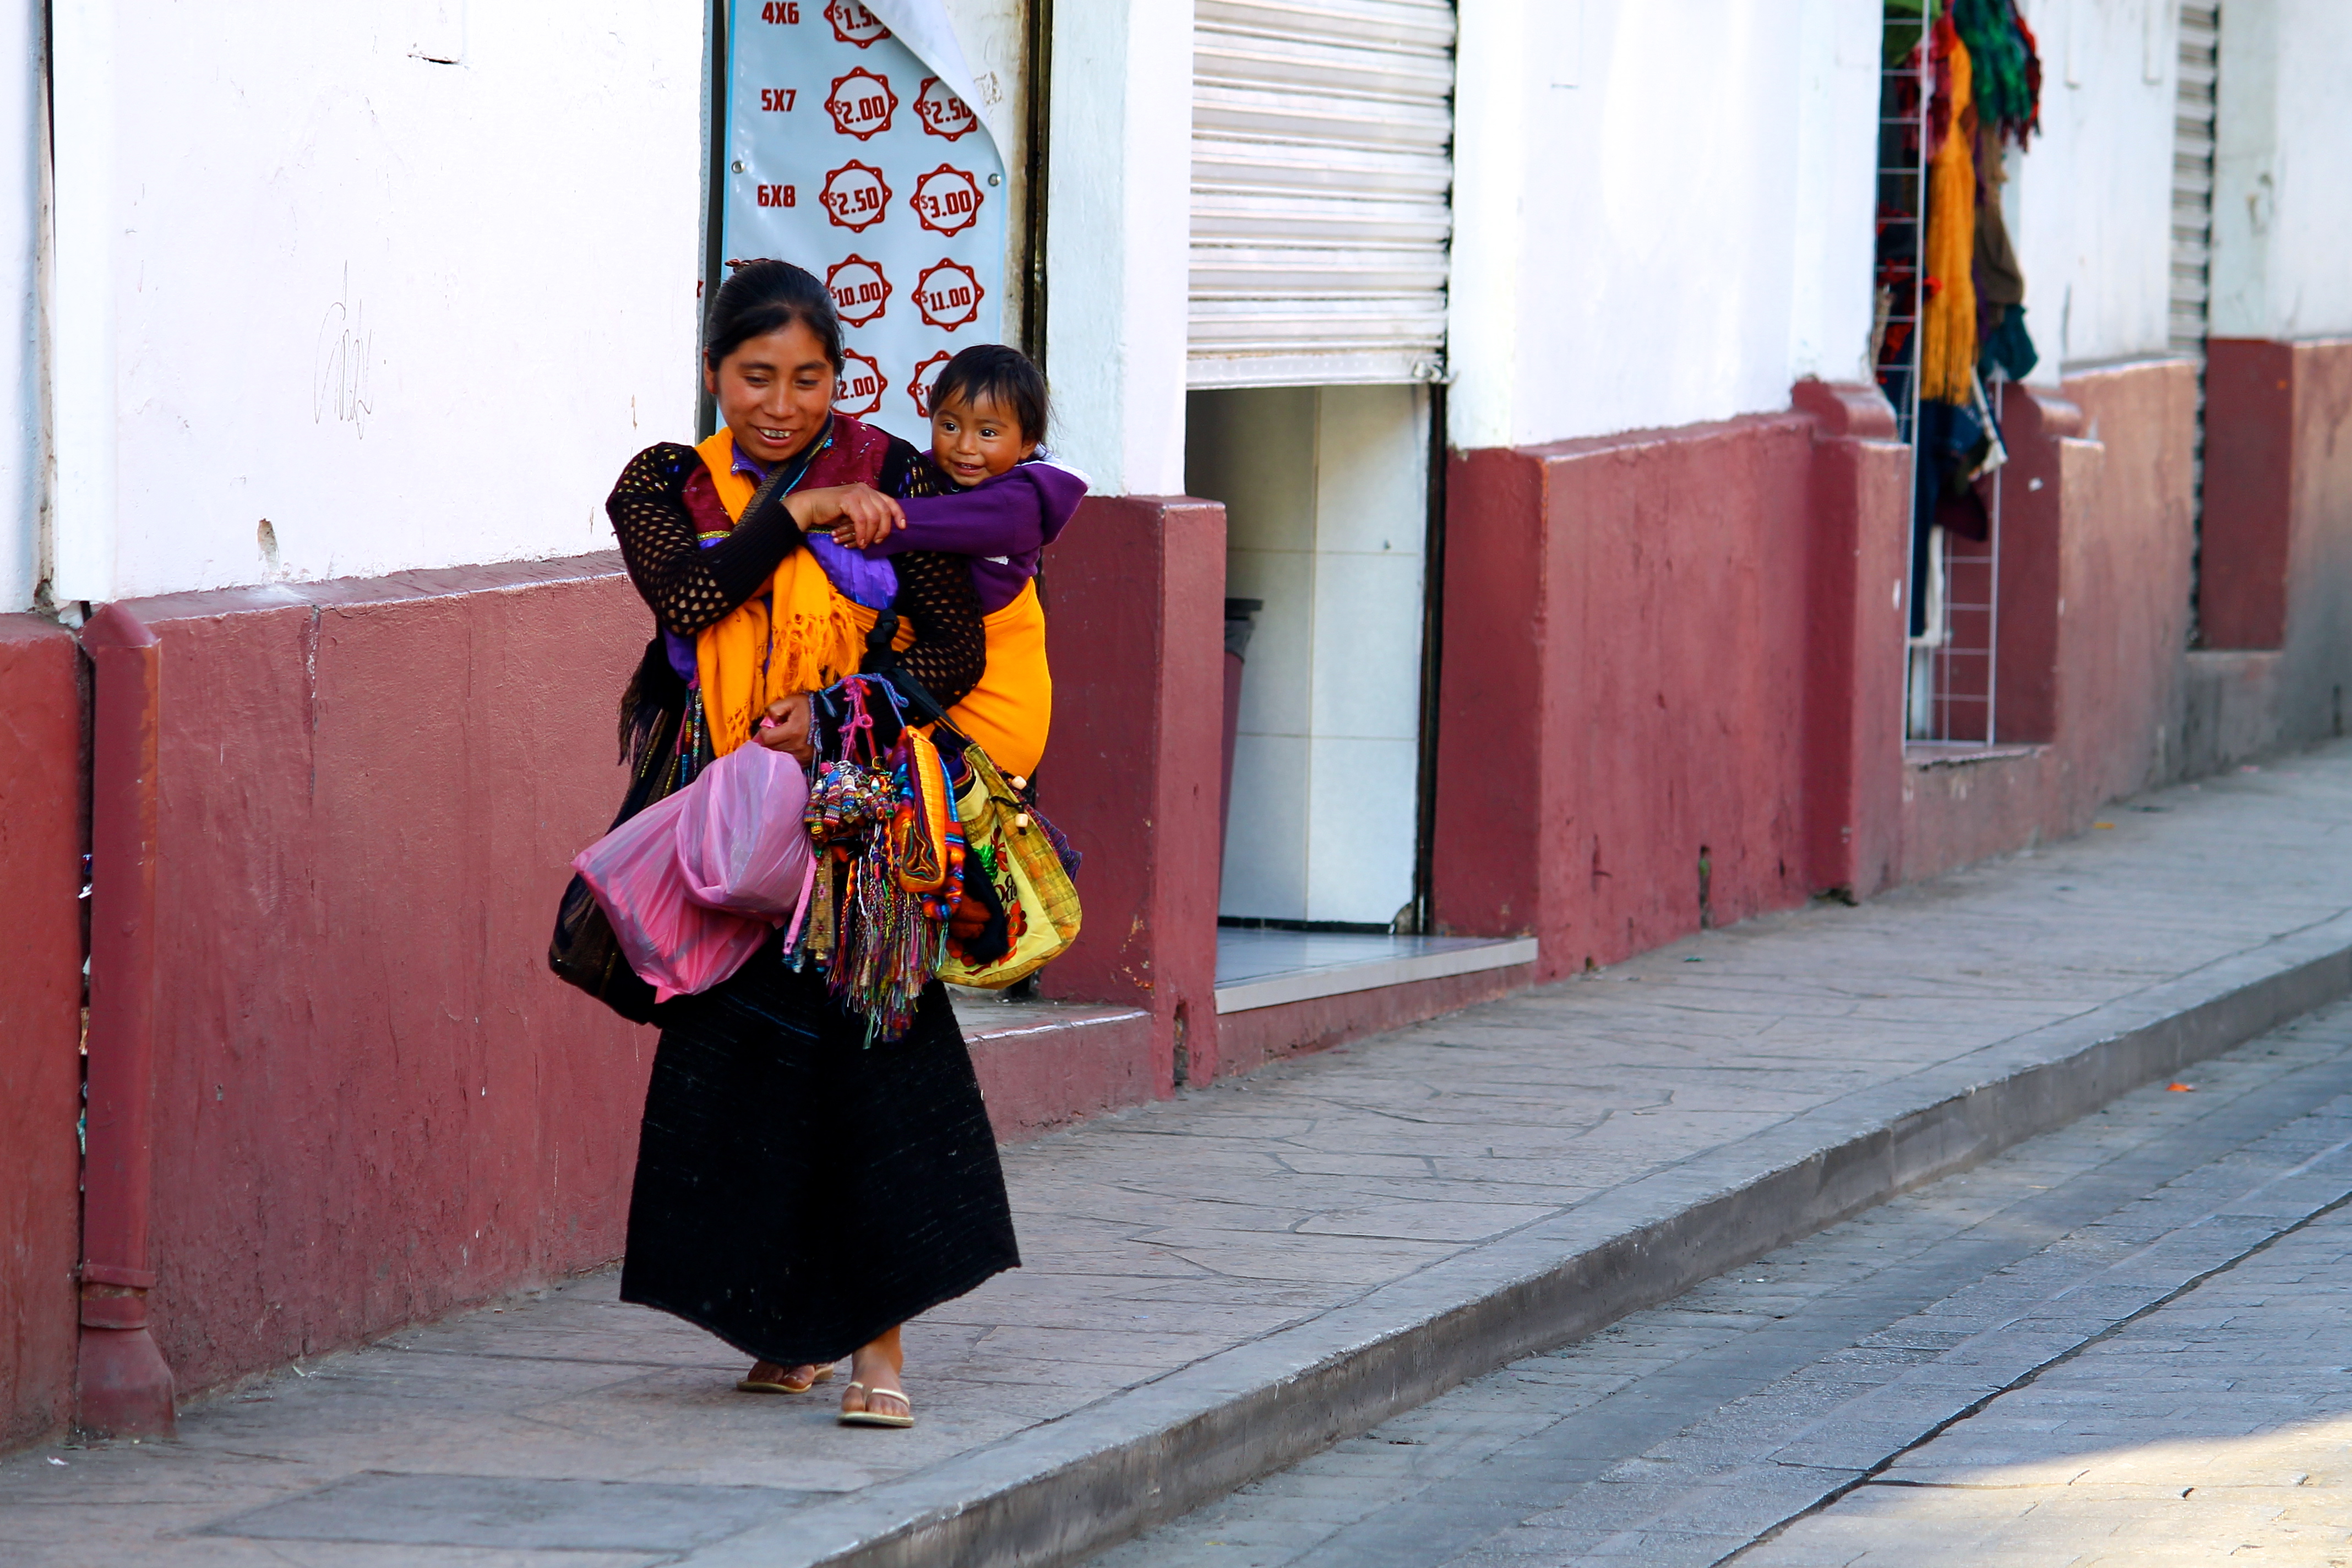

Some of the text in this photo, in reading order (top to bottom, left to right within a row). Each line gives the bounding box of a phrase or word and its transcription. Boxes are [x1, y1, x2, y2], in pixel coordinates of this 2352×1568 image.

[762, 2, 799, 24] 4X6
[761, 89, 797, 112] 5X7
[835, 95, 886, 124] $2.00
[758, 184, 972, 219] 6X8 $2.50 $3.00
[830, 281, 971, 312] $10.00 $11.00
